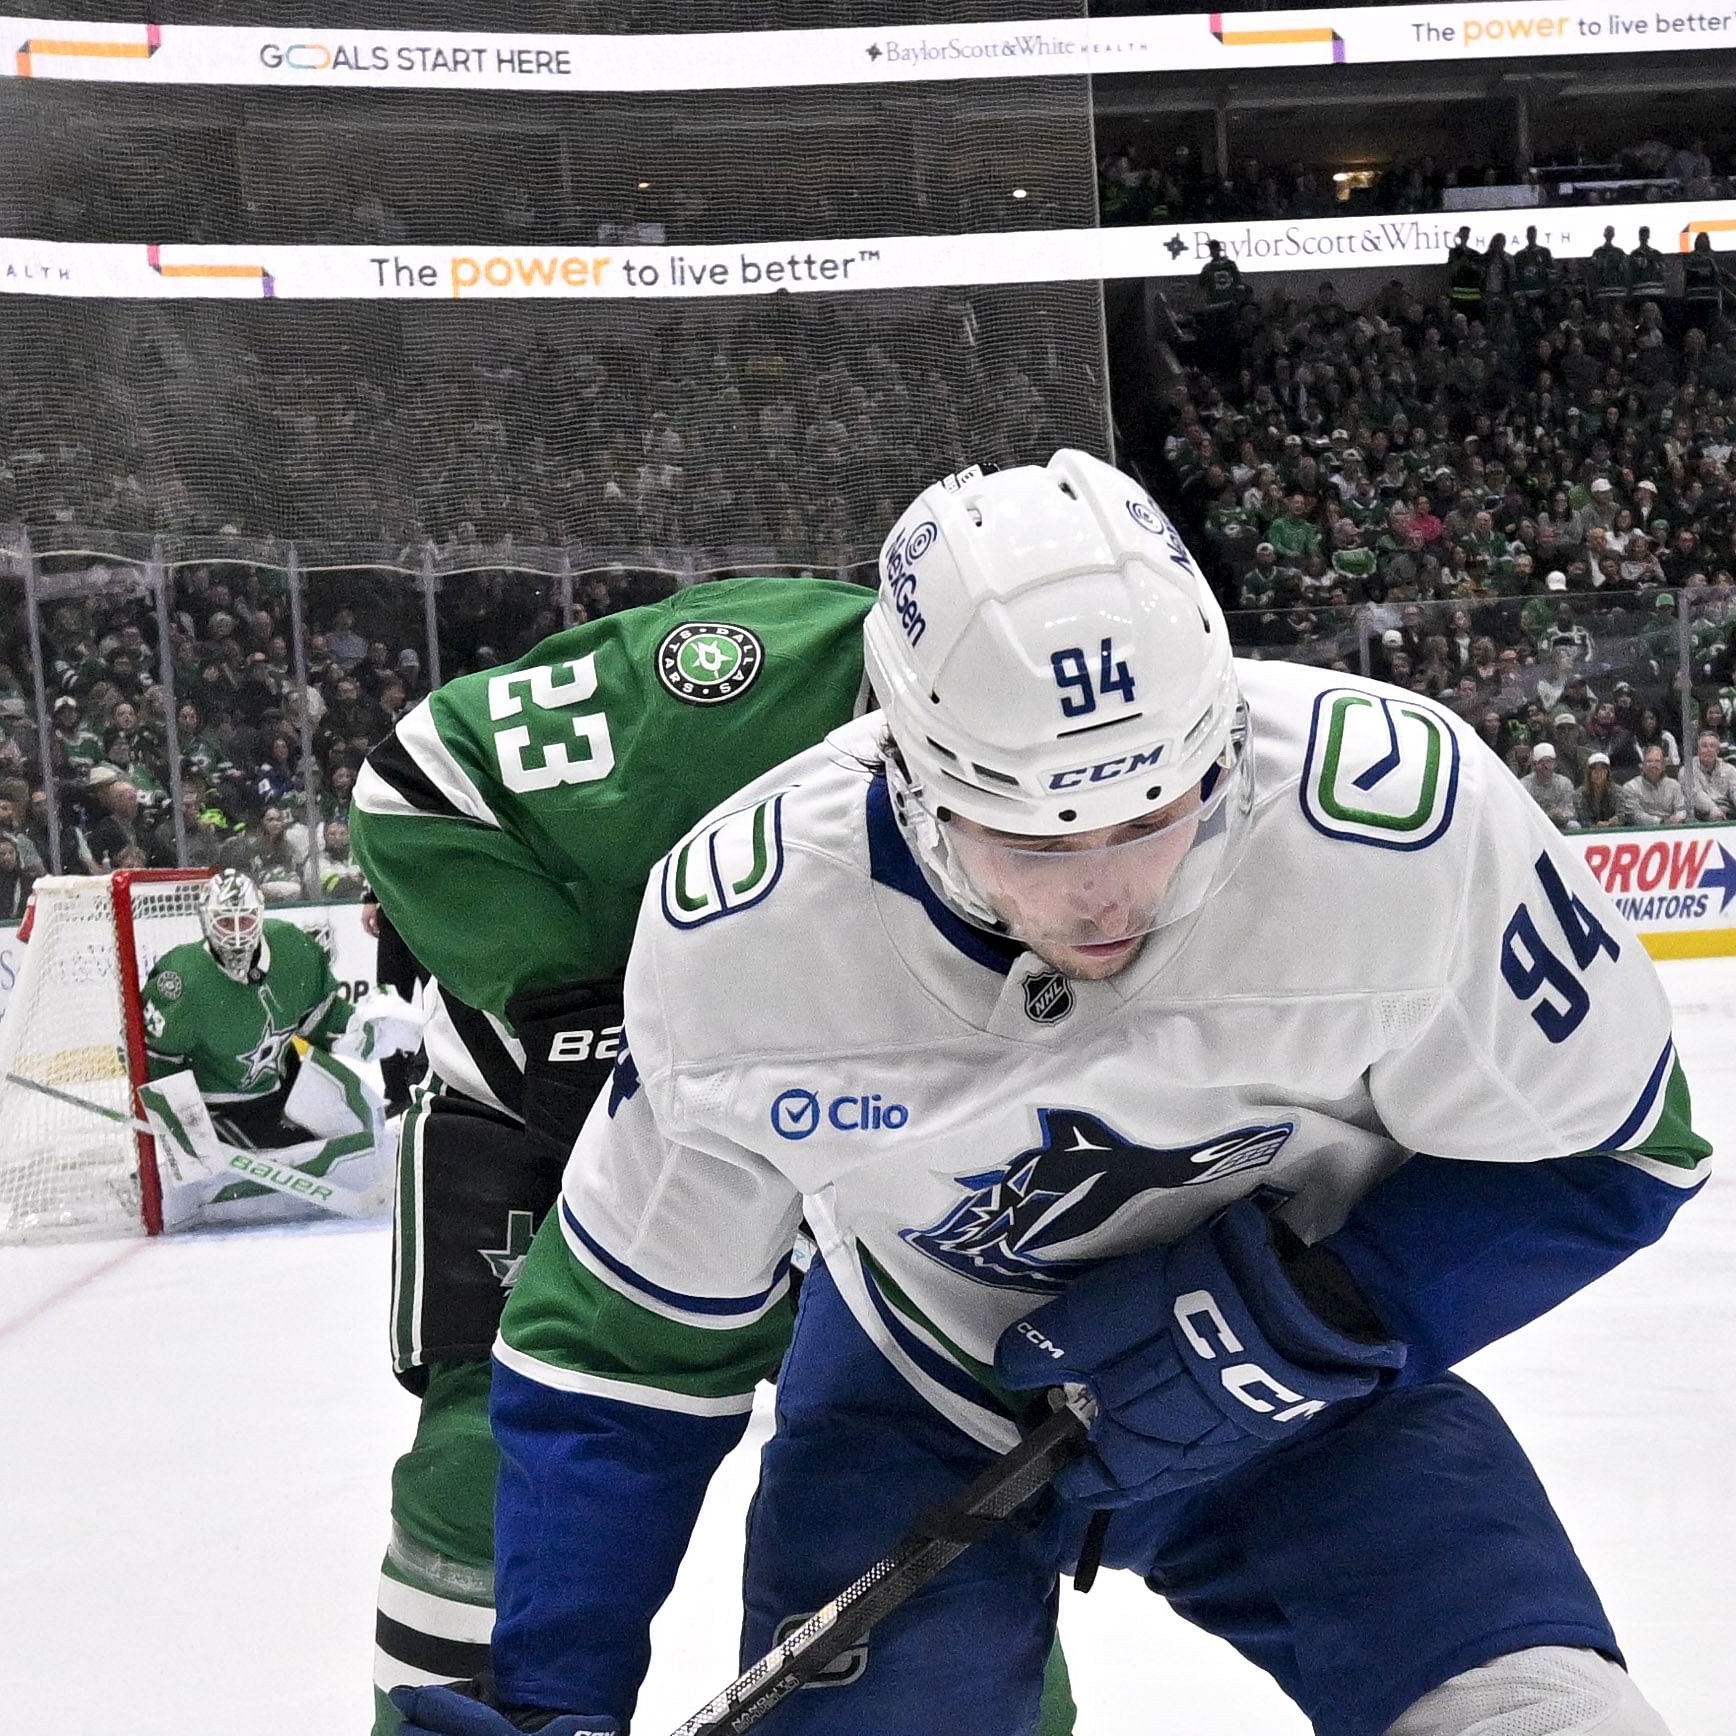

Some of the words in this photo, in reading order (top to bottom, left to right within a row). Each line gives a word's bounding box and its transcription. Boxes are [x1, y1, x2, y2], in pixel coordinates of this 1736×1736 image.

[1411, 23, 1456, 42] The
[1464, 15, 1570, 48] power
[1578, 18, 1602, 36] to
[1609, 14, 1649, 35] live
[397, 46, 487, 73] START
[496, 49, 572, 75] HERE
[370, 256, 439, 288] The
[450, 255, 612, 301] power
[622, 262, 660, 287] to
[671, 256, 730, 287] live
[715, 626, 754, 694] DALLAS
[1050, 636, 1136, 718] 94
[488, 650, 616, 794] 23
[1048, 743, 1166, 791] CCM
[1499, 848, 1622, 1044] 94
[1030, 978, 1067, 1017] NHL
[828, 1094, 910, 1131] Clio
[1016, 1320, 1065, 1360] CCM
